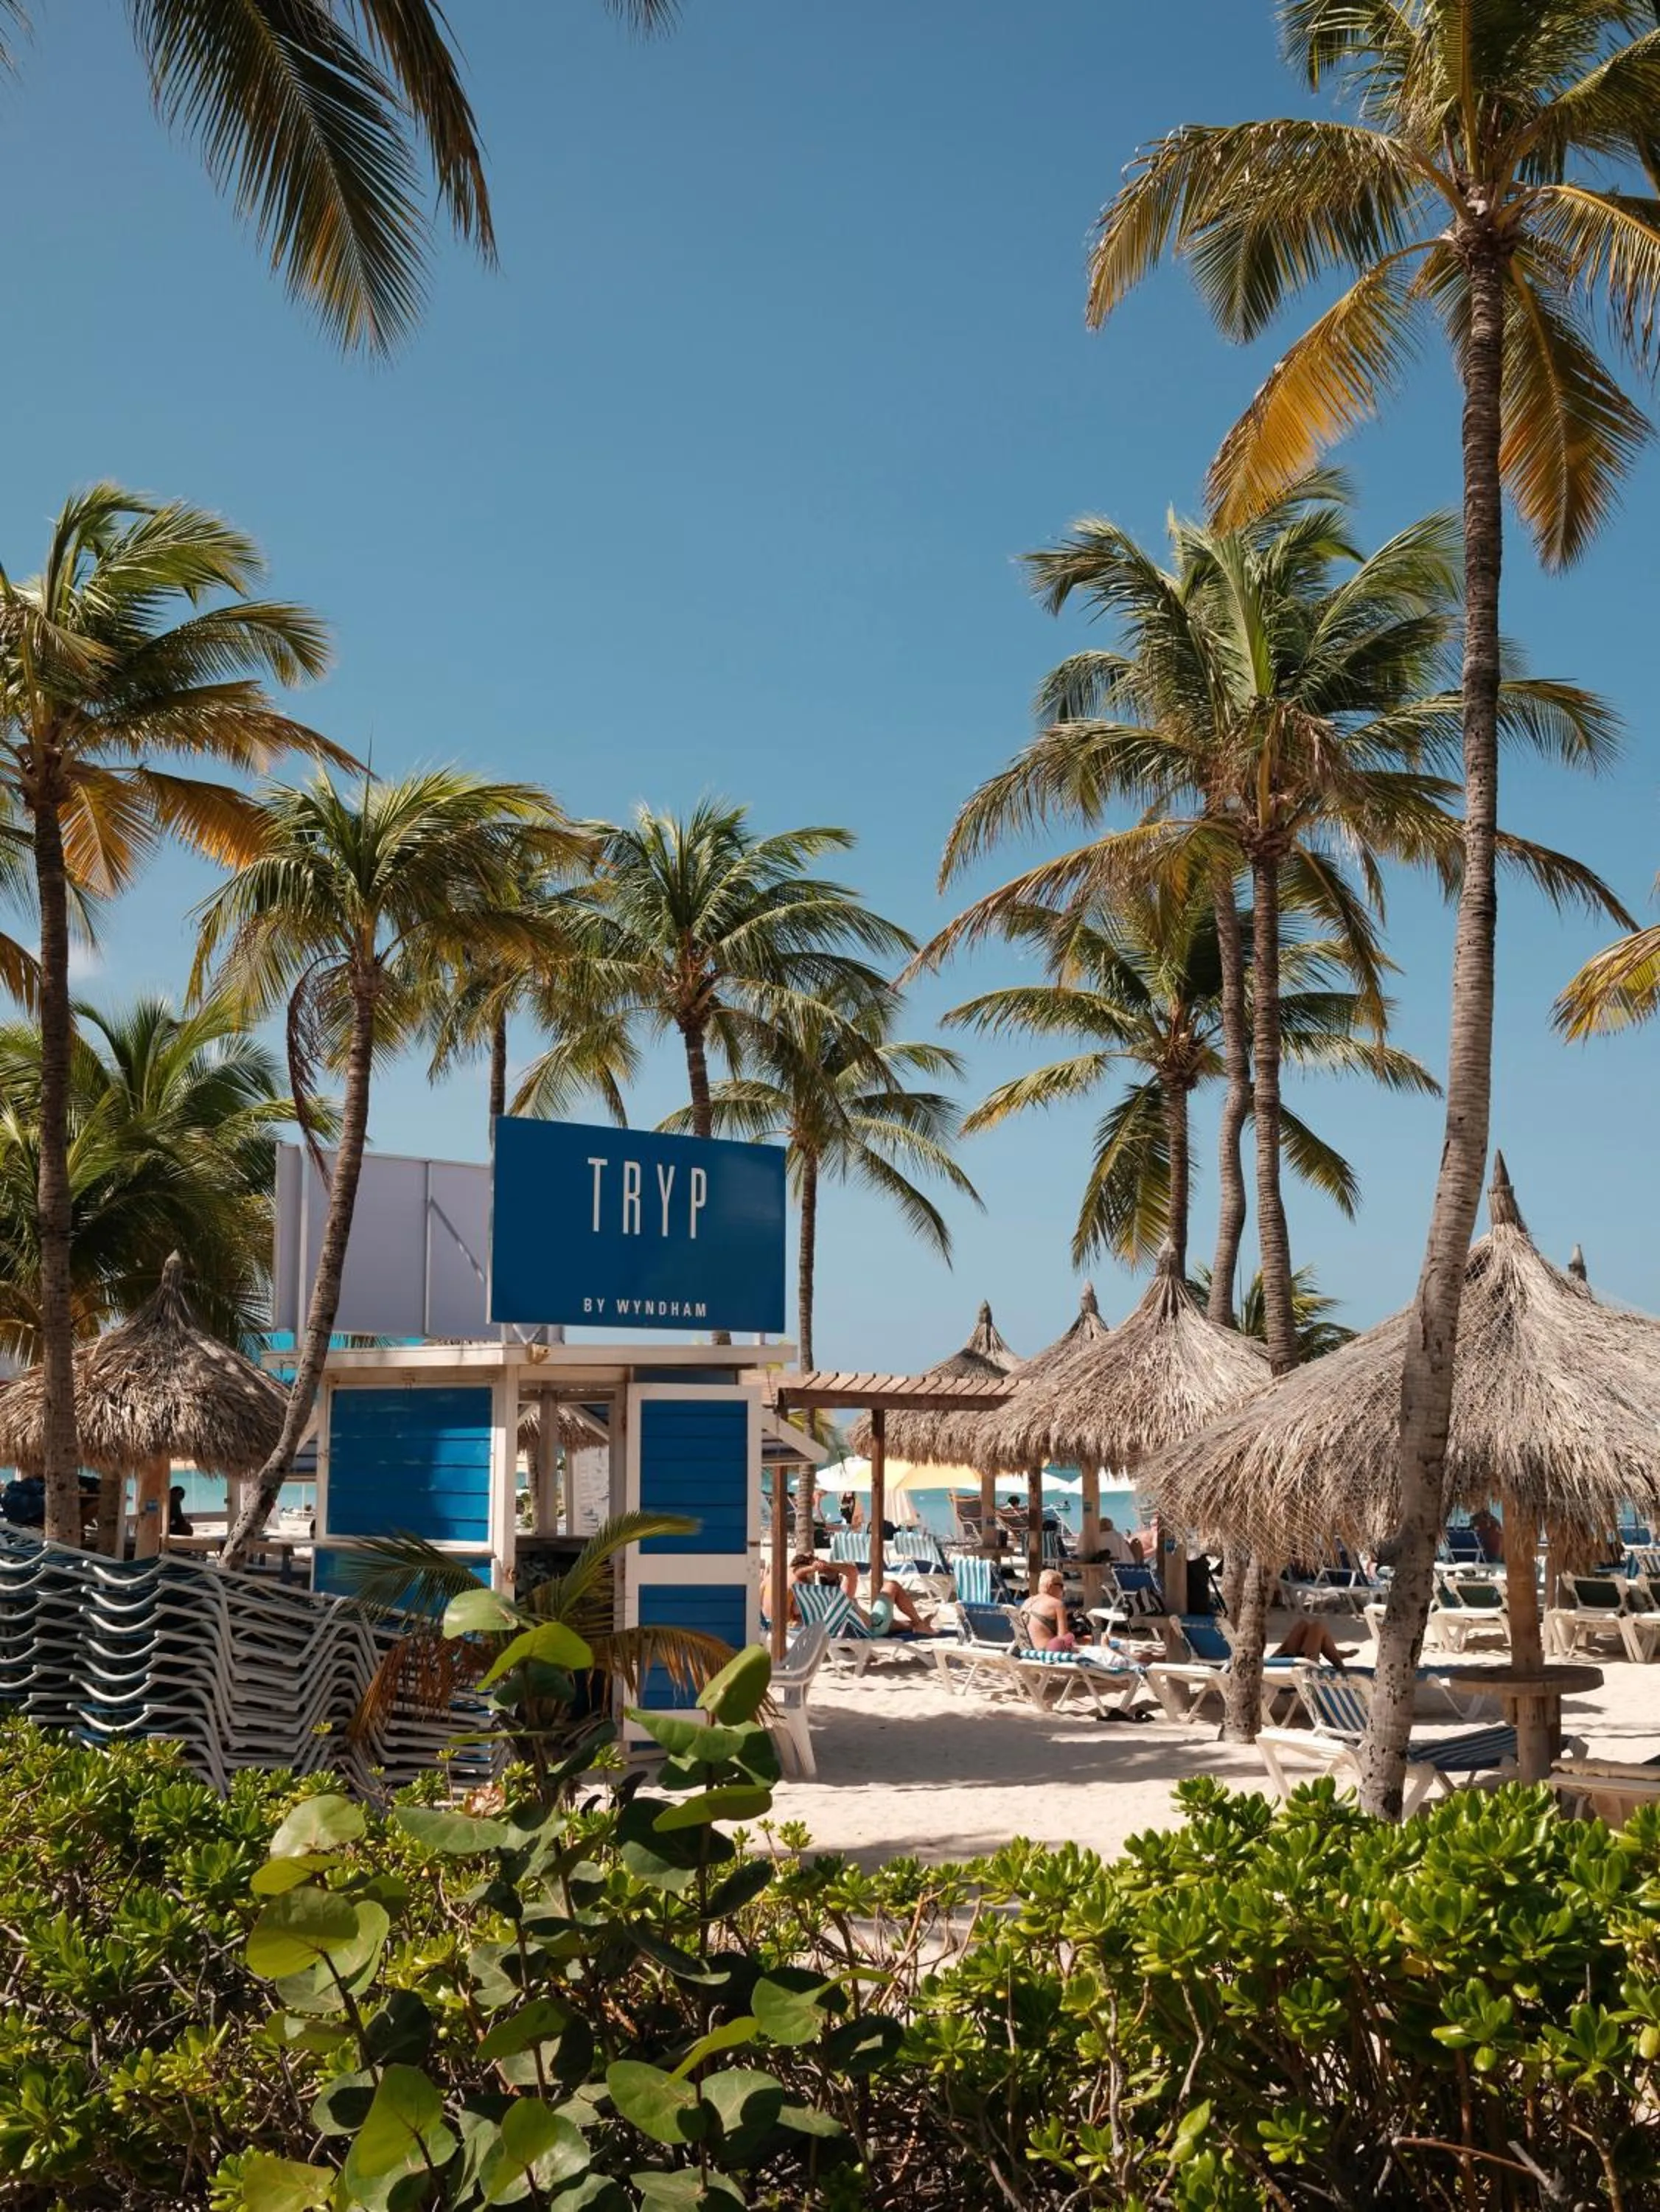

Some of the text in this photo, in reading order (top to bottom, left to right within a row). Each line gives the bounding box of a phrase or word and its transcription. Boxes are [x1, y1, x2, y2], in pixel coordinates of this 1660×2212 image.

[588, 1158, 707, 1239] TRYP
[584, 1298, 707, 1318] BY WYNDHAM
